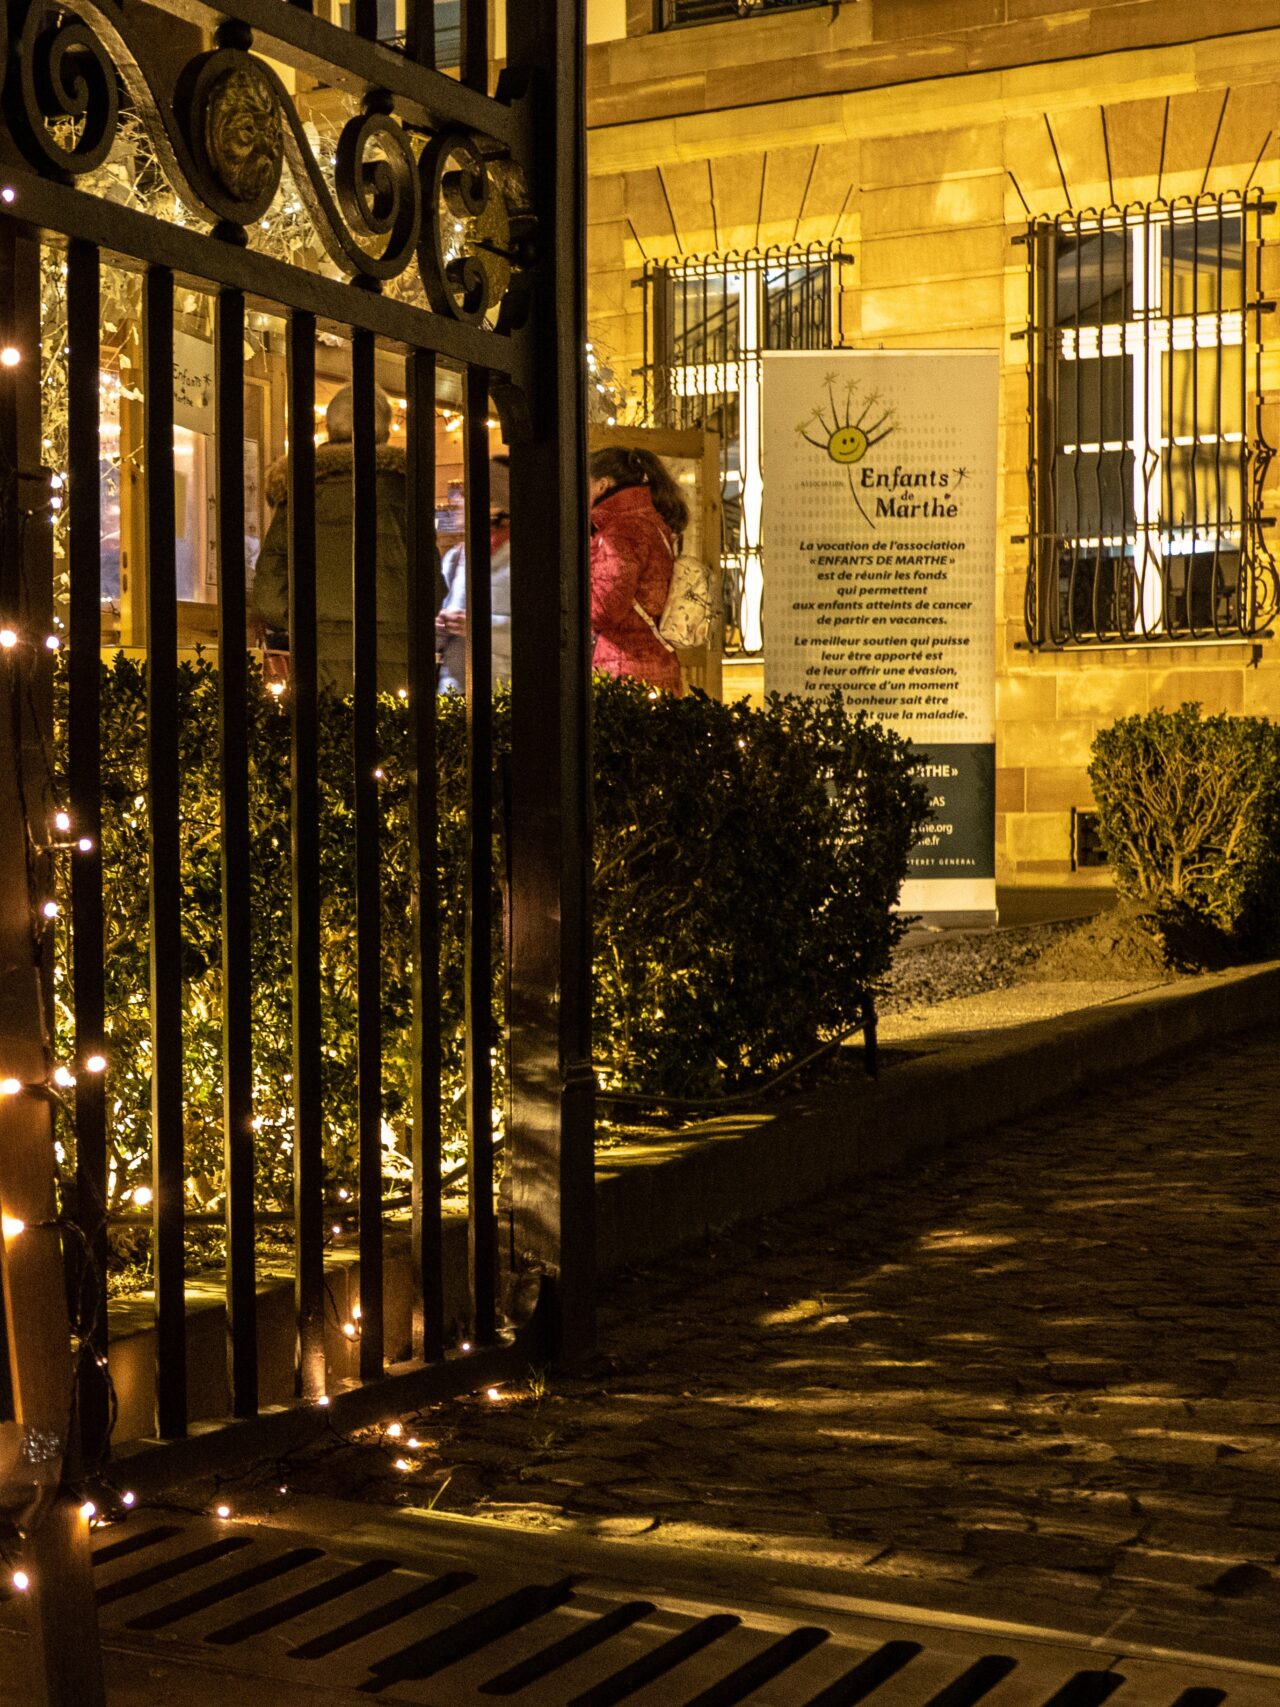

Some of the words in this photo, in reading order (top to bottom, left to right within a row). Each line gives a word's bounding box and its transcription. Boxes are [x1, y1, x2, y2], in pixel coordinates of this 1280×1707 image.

[860, 466, 949, 491] Enfants
[900, 490, 914, 501] de
[875, 497, 959, 518] Marthe
[799, 541, 814, 551] La
[816, 541, 869, 551] vocation
[872, 541, 887, 551] de
[890, 541, 966, 551] l'association
[876, 555, 893, 566] DE
[817, 571, 835, 580] est
[837, 570, 852, 580] de
[855, 570, 893, 580] réunir
[894, 570, 911, 580] les
[913, 570, 948, 580] fonds
[836, 586, 857, 597] qui
[859, 586, 928, 597] permettent
[792, 602, 815, 610] aux
[817, 600, 863, 610] enfants
[866, 600, 913, 610] atteints
[915, 600, 930, 610] de
[932, 602, 972, 610] cancer
[816, 615, 832, 625] de
[833, 615, 870, 626] partir
[872, 617, 887, 625] en
[889, 617, 948, 625] vacances.
[794, 637, 808, 646] Le
[810, 636, 861, 646] meilleur
[863, 636, 908, 646] soutien
[910, 636, 930, 647] qui
[932, 636, 970, 647] puisse
[821, 651, 845, 661] leur
[847, 651, 872, 661] être
[874, 651, 923, 663] apporté
[925, 652, 944, 661] est
[806, 666, 821, 676] de
[823, 666, 847, 676] leur
[849, 666, 881, 676] offrir
[883, 667, 906, 676] une
[908, 666, 957, 677] évasion,
[805, 681, 817, 690] la
[818, 682, 877, 690] ressource
[879, 681, 906, 690] d'un
[908, 682, 959, 690] moment
[846, 696, 899, 705] bonheur
[900, 696, 923, 705] sait
[925, 695, 949, 705] être
[877, 711, 898, 720] que
[902, 710, 914, 719] la
[915, 710, 968, 719] maladie.
